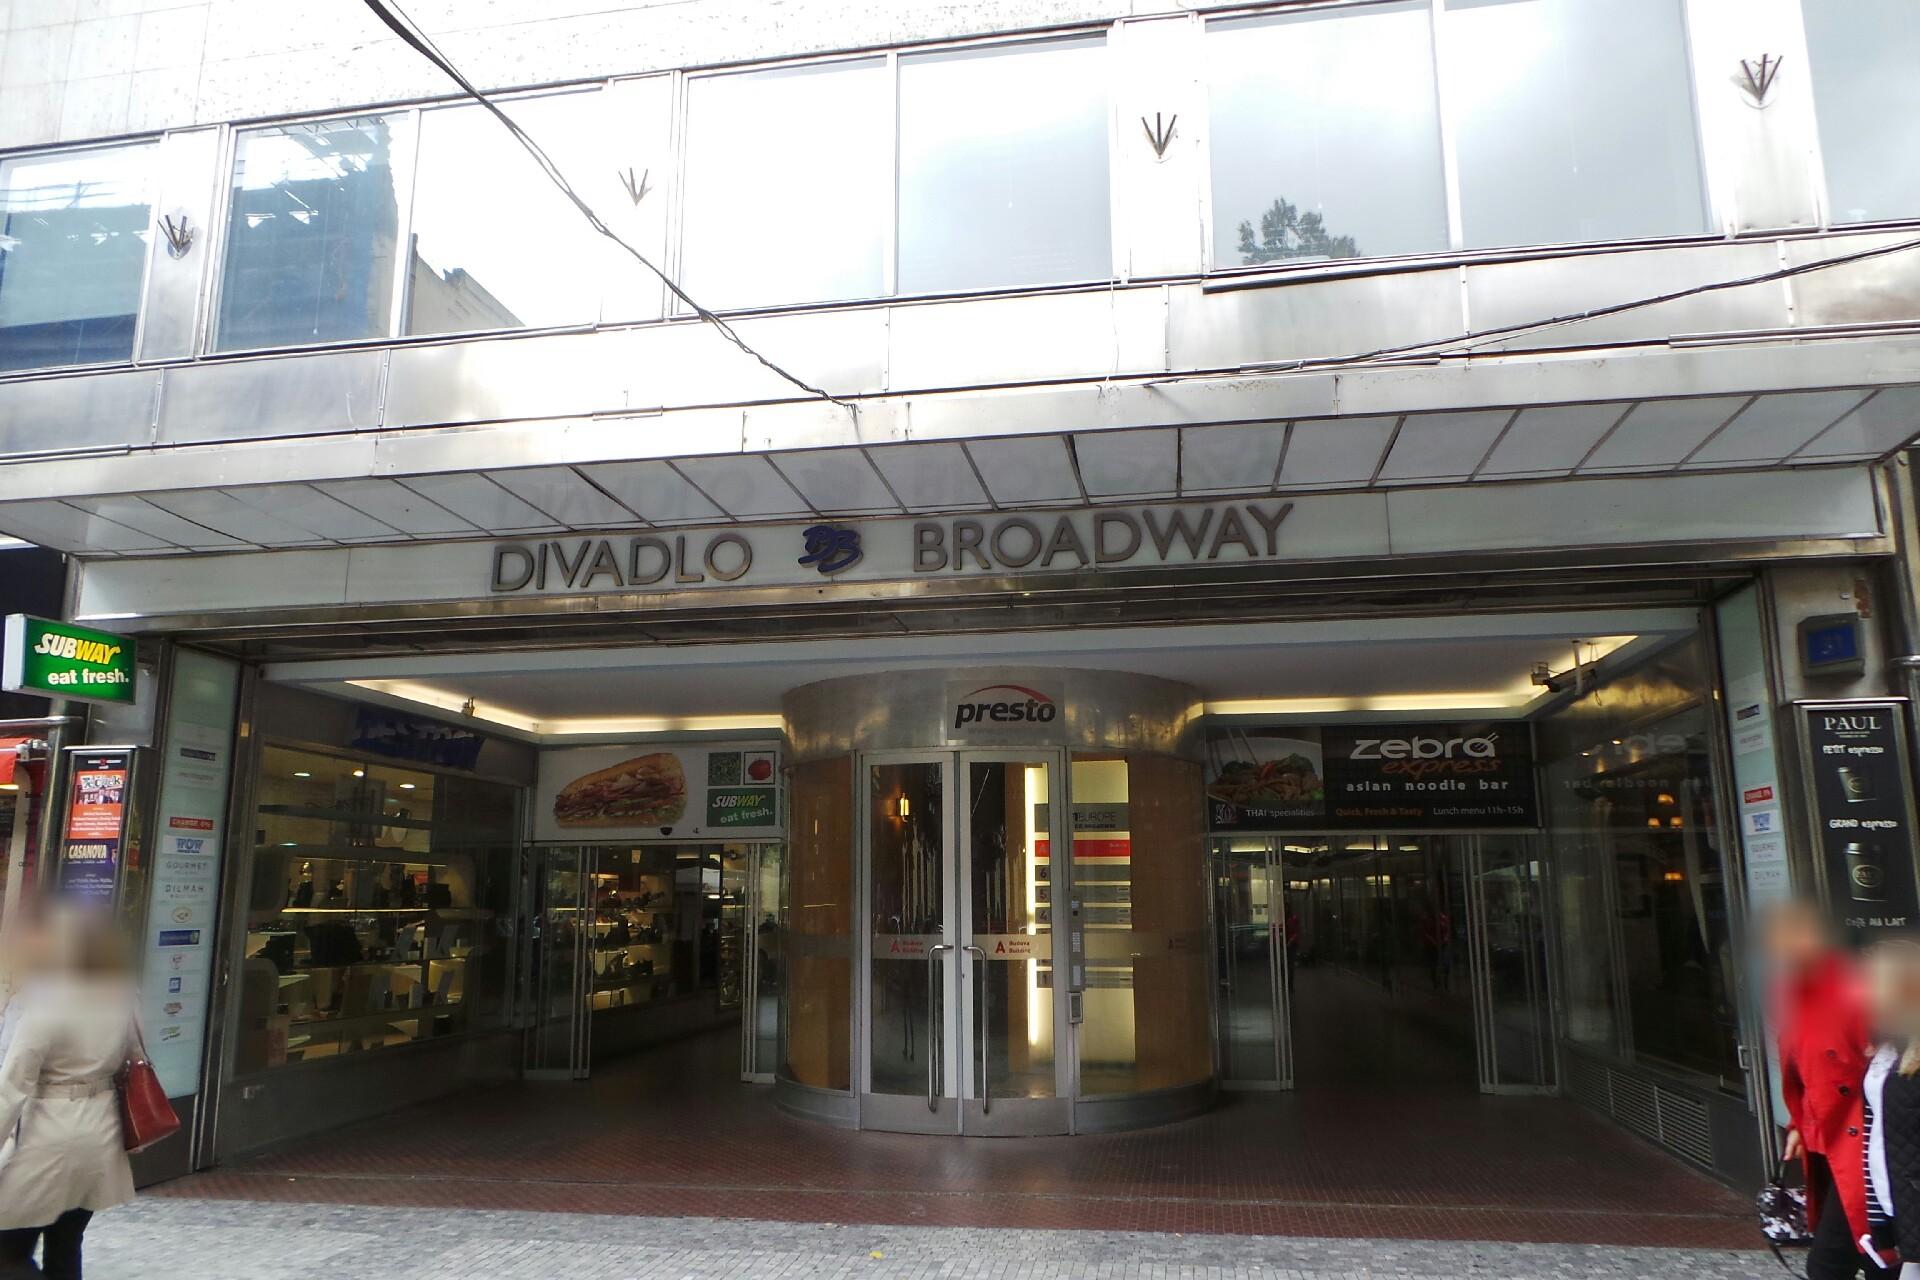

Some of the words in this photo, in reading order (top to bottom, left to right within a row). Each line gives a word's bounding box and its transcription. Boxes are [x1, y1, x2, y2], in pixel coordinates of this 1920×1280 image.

[491, 532, 753, 592] DIVADLO
[913, 503, 1294, 572] BROADWAY
[34, 632, 121, 665] SUBWAY
[47, 669, 79, 685] eat
[82, 667, 129, 684] fresh.
[955, 698, 1057, 729] presto
[1824, 716, 1882, 731] PAUL
[1350, 732, 1499, 760] zebra
[1380, 758, 1502, 779] express
[1346, 779, 1392, 792] asian
[1404, 778, 1466, 791] noodle
[1479, 777, 1509, 791] bar
[712, 794, 766, 808] SUBWAY
[720, 812, 739, 824] eat
[1246, 809, 1268, 817] THAI
[1433, 807, 1460, 816] Lunch
[1829, 819, 1859, 829] GRAND
[68, 844, 107, 860] CASANOVA
[1040, 867, 1047, 879] 6
[1039, 888, 1048, 900] 5
[890, 941, 900, 953] A
[995, 941, 1006, 954] A
